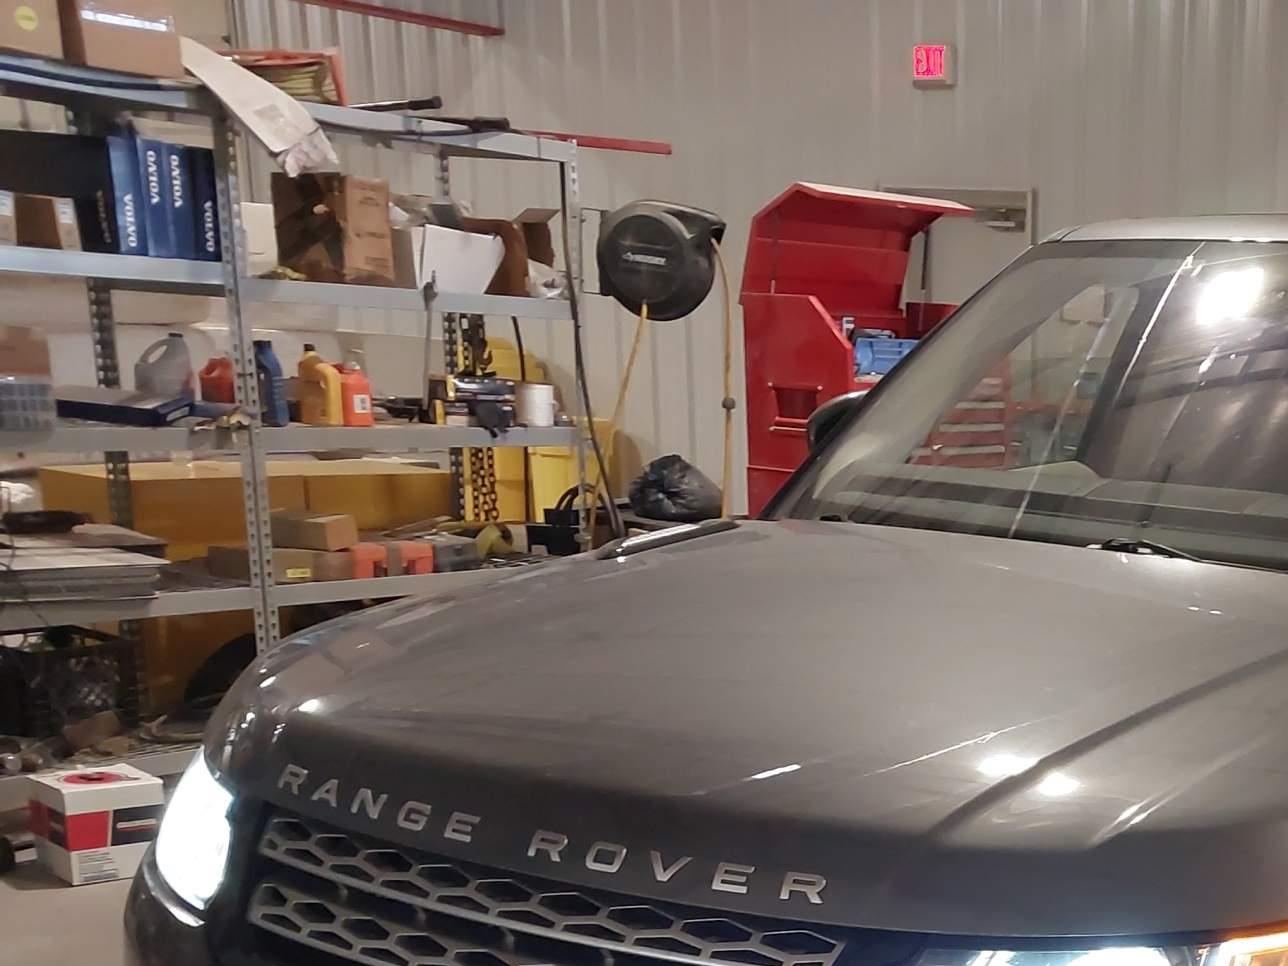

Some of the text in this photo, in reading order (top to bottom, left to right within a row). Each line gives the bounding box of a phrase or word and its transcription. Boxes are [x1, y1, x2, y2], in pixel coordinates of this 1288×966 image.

[146, 150, 160, 206] VOLVO
[170, 154, 184, 209] VOLVO
[123, 193, 138, 248] VOLVO
[203, 200, 216, 252] VOLVO
[277, 763, 827, 905] RANGE ROVER
